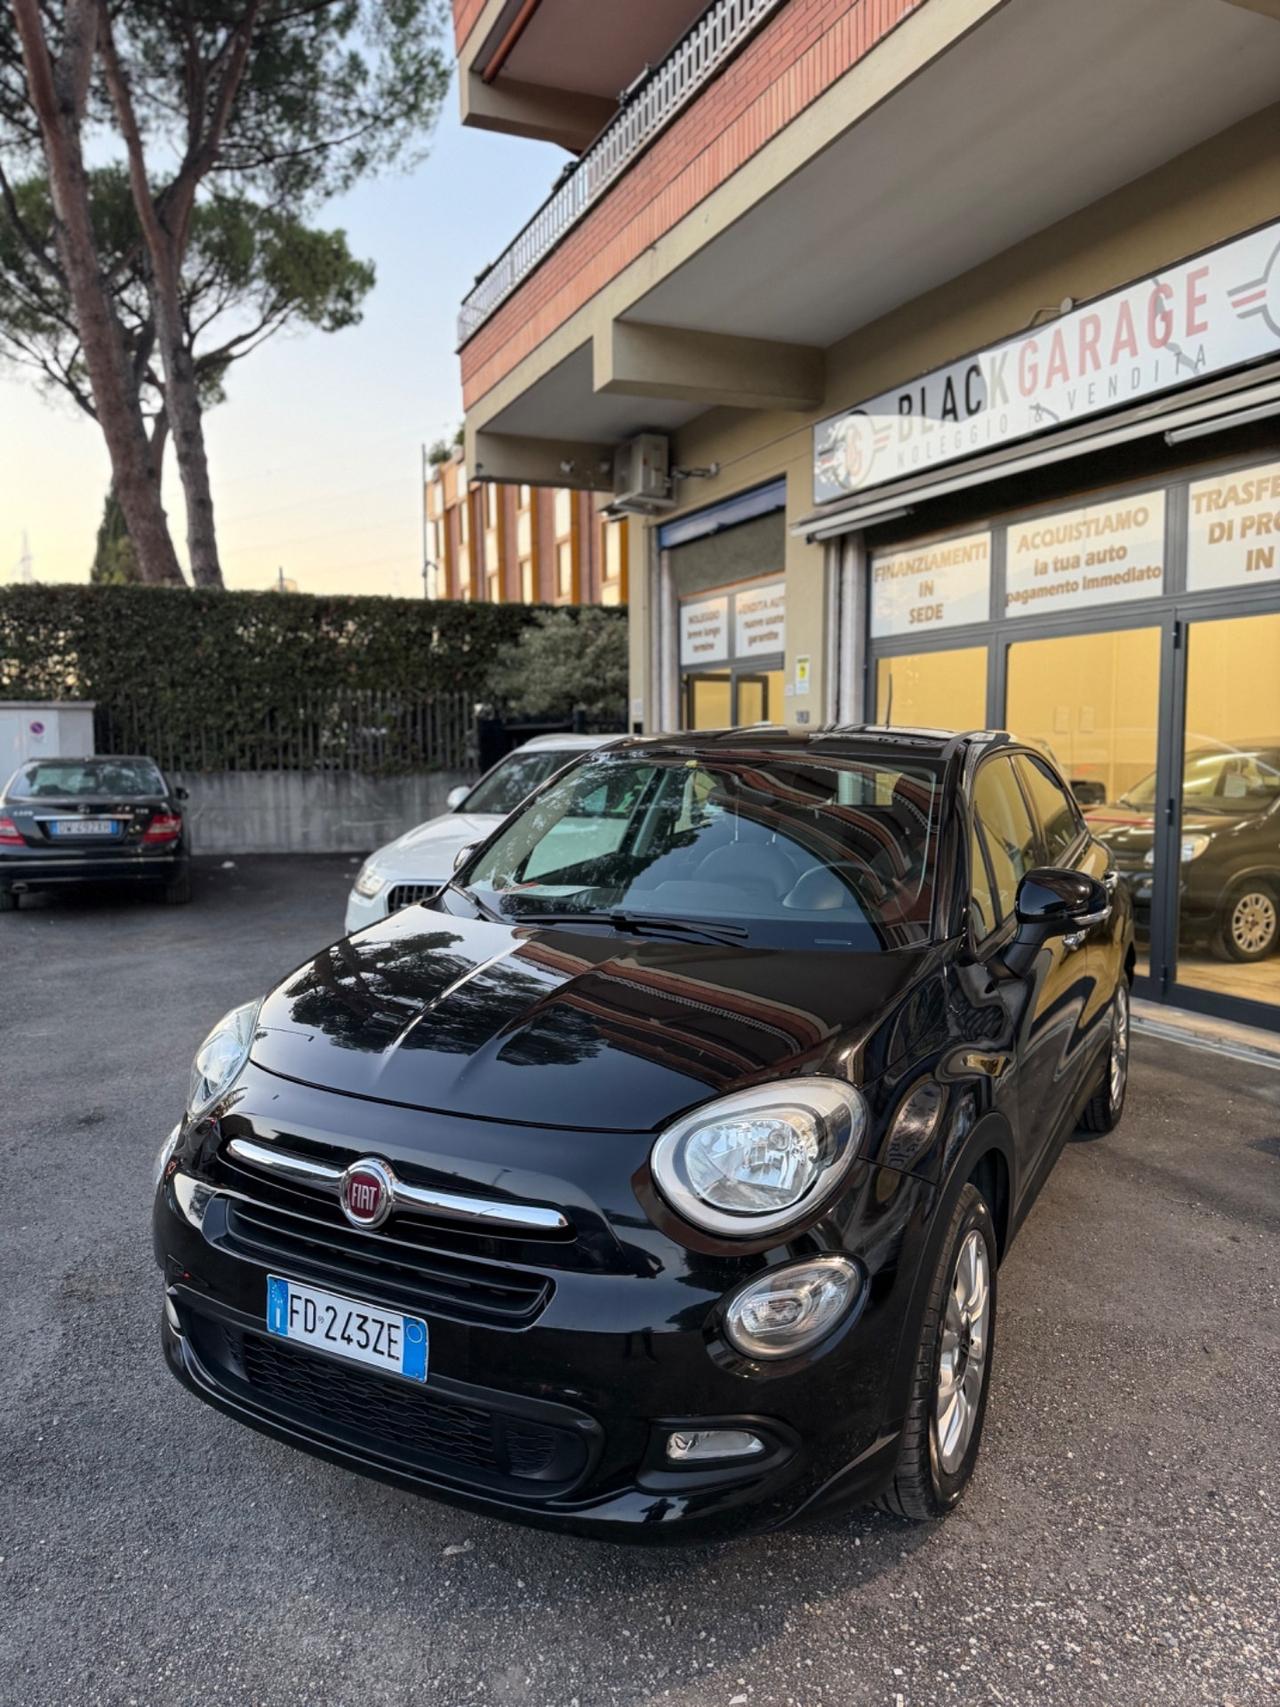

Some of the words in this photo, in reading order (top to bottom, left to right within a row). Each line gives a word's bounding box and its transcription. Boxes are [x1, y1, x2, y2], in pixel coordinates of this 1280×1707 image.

[897, 413, 1008, 467] NOLEGGIO
[1067, 344, 1207, 410] VENDITA
[1016, 507, 1149, 553] ACQUISTIAMO
[1208, 520, 1234, 545] DI
[874, 542, 988, 582] FINANZIAMENTI
[1034, 558, 1048, 576] la
[1053, 554, 1080, 572] tua
[1085, 545, 1127, 566] auto
[1246, 546, 1274, 572] IN
[918, 580, 934, 598] IN
[1006, 581, 1079, 607] pagamento
[1083, 566, 1162, 590] immediato
[909, 603, 944, 624] SEDE
[351, 1182, 378, 1211] FIAT
